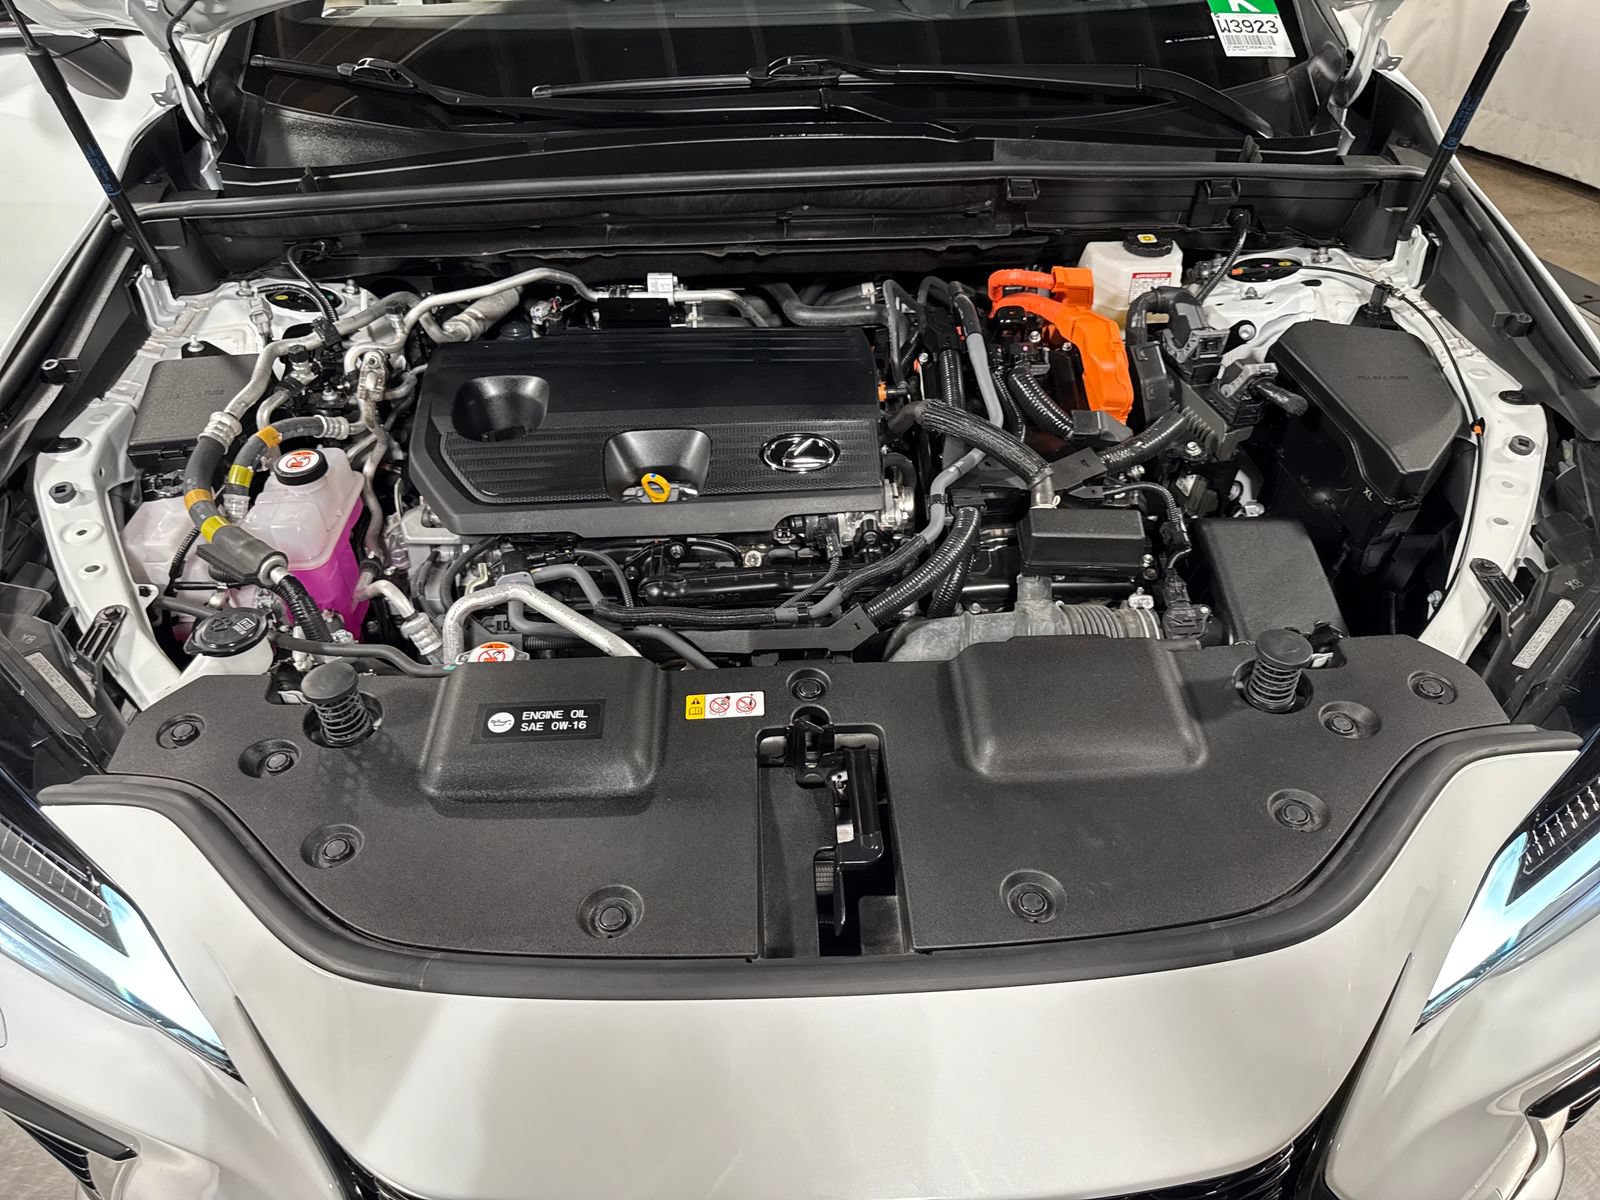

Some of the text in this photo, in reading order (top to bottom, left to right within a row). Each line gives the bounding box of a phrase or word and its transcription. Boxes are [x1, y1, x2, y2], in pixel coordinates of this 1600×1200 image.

[1216, 19, 1279, 34] W3923
[521, 709, 588, 721] ENGINE OIL
[520, 720, 587, 732] SAE 0W-16
